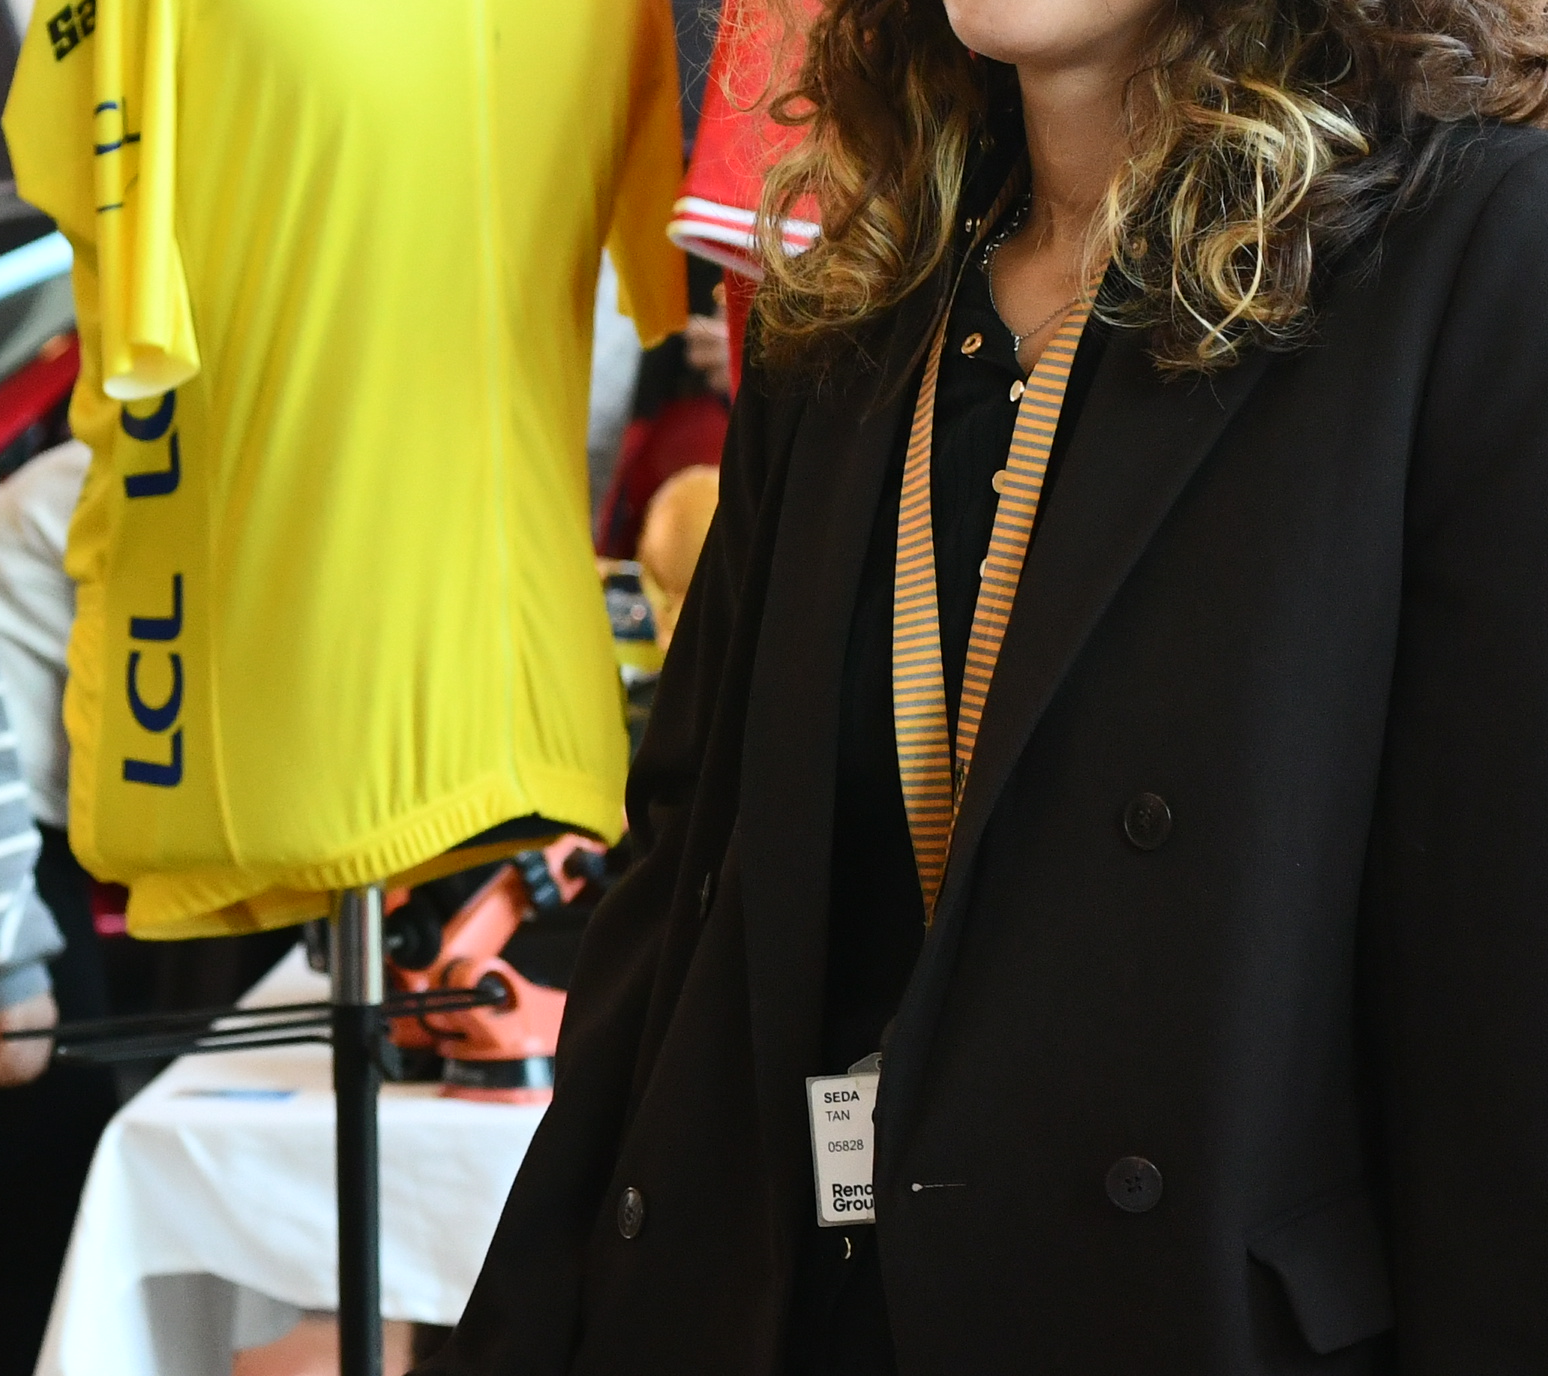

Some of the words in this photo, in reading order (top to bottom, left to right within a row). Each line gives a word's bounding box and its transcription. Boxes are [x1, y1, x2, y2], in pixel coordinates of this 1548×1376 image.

[120, 388, 182, 499] LC
[122, 572, 184, 788] LCL
[824, 1091, 860, 1103] SEDA
[826, 1110, 850, 1121] TAN
[828, 1139, 864, 1152] 05828
[833, 1198, 873, 1211] Grou
